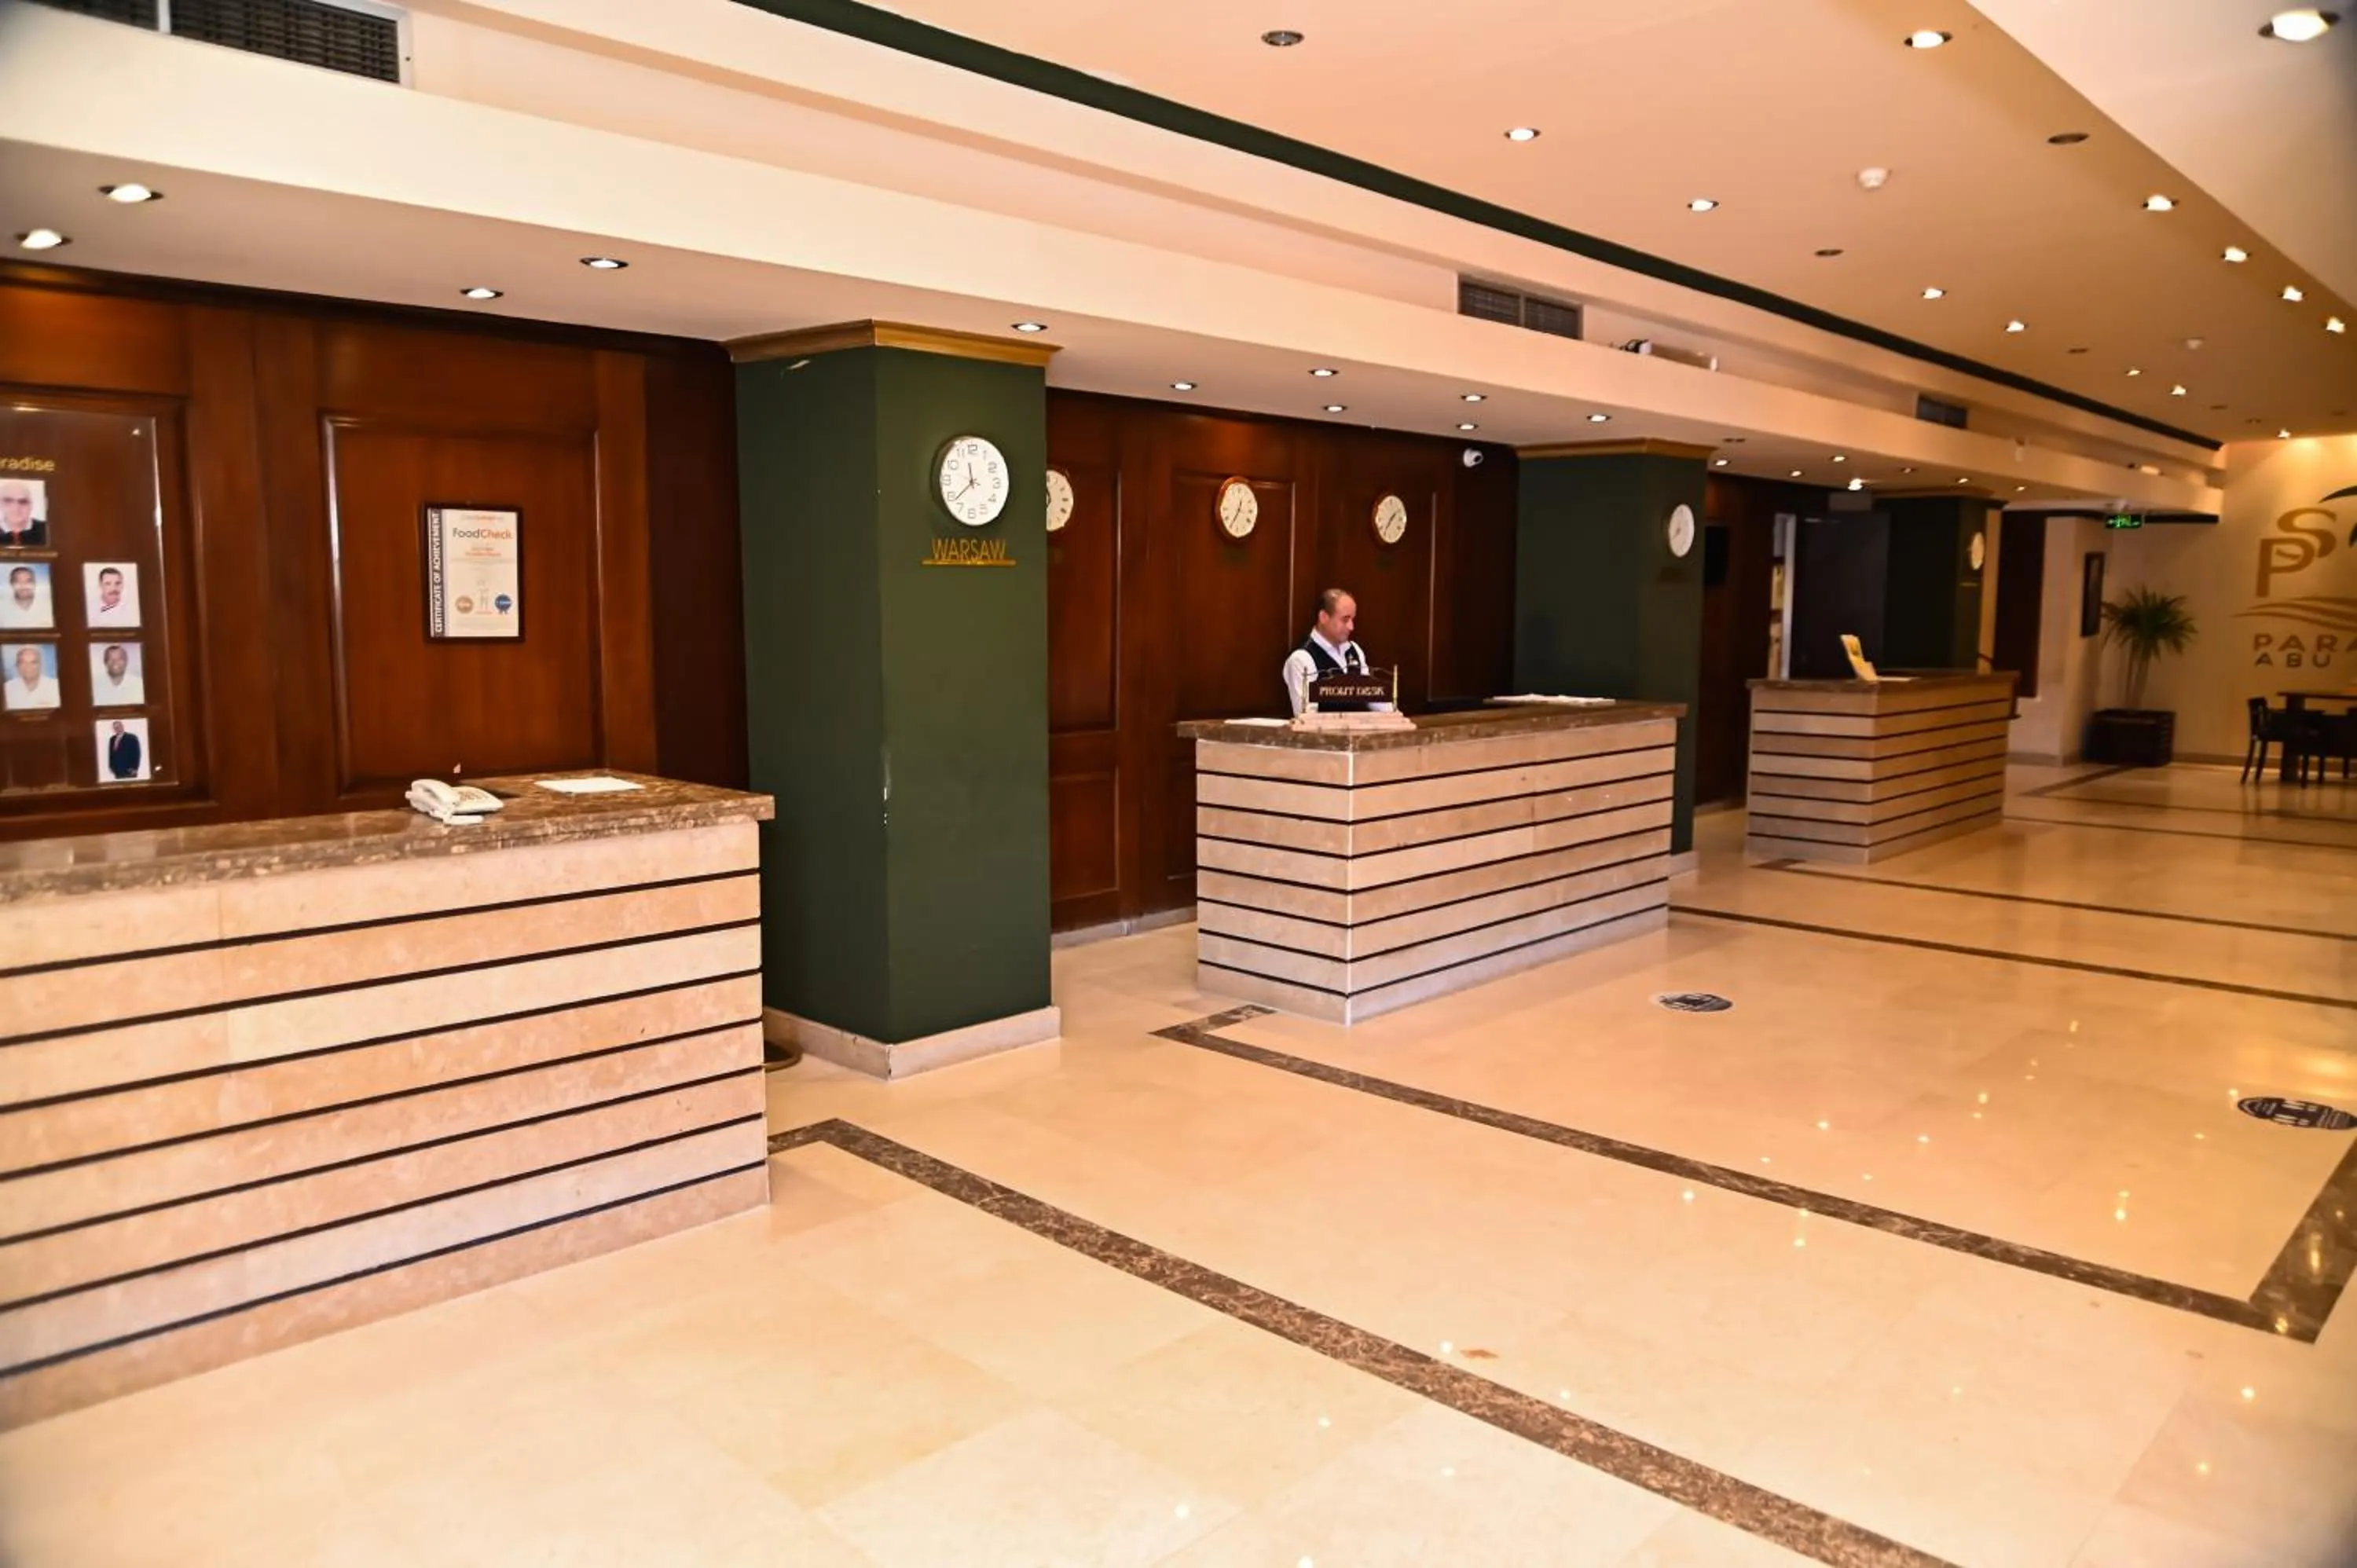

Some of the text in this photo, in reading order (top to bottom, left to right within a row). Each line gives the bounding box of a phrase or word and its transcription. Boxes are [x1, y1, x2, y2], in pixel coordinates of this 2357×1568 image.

[453, 528, 513, 540] FoodCheck
[932, 538, 1006, 560] WARSAW
[2254, 652, 2332, 669] ABU
